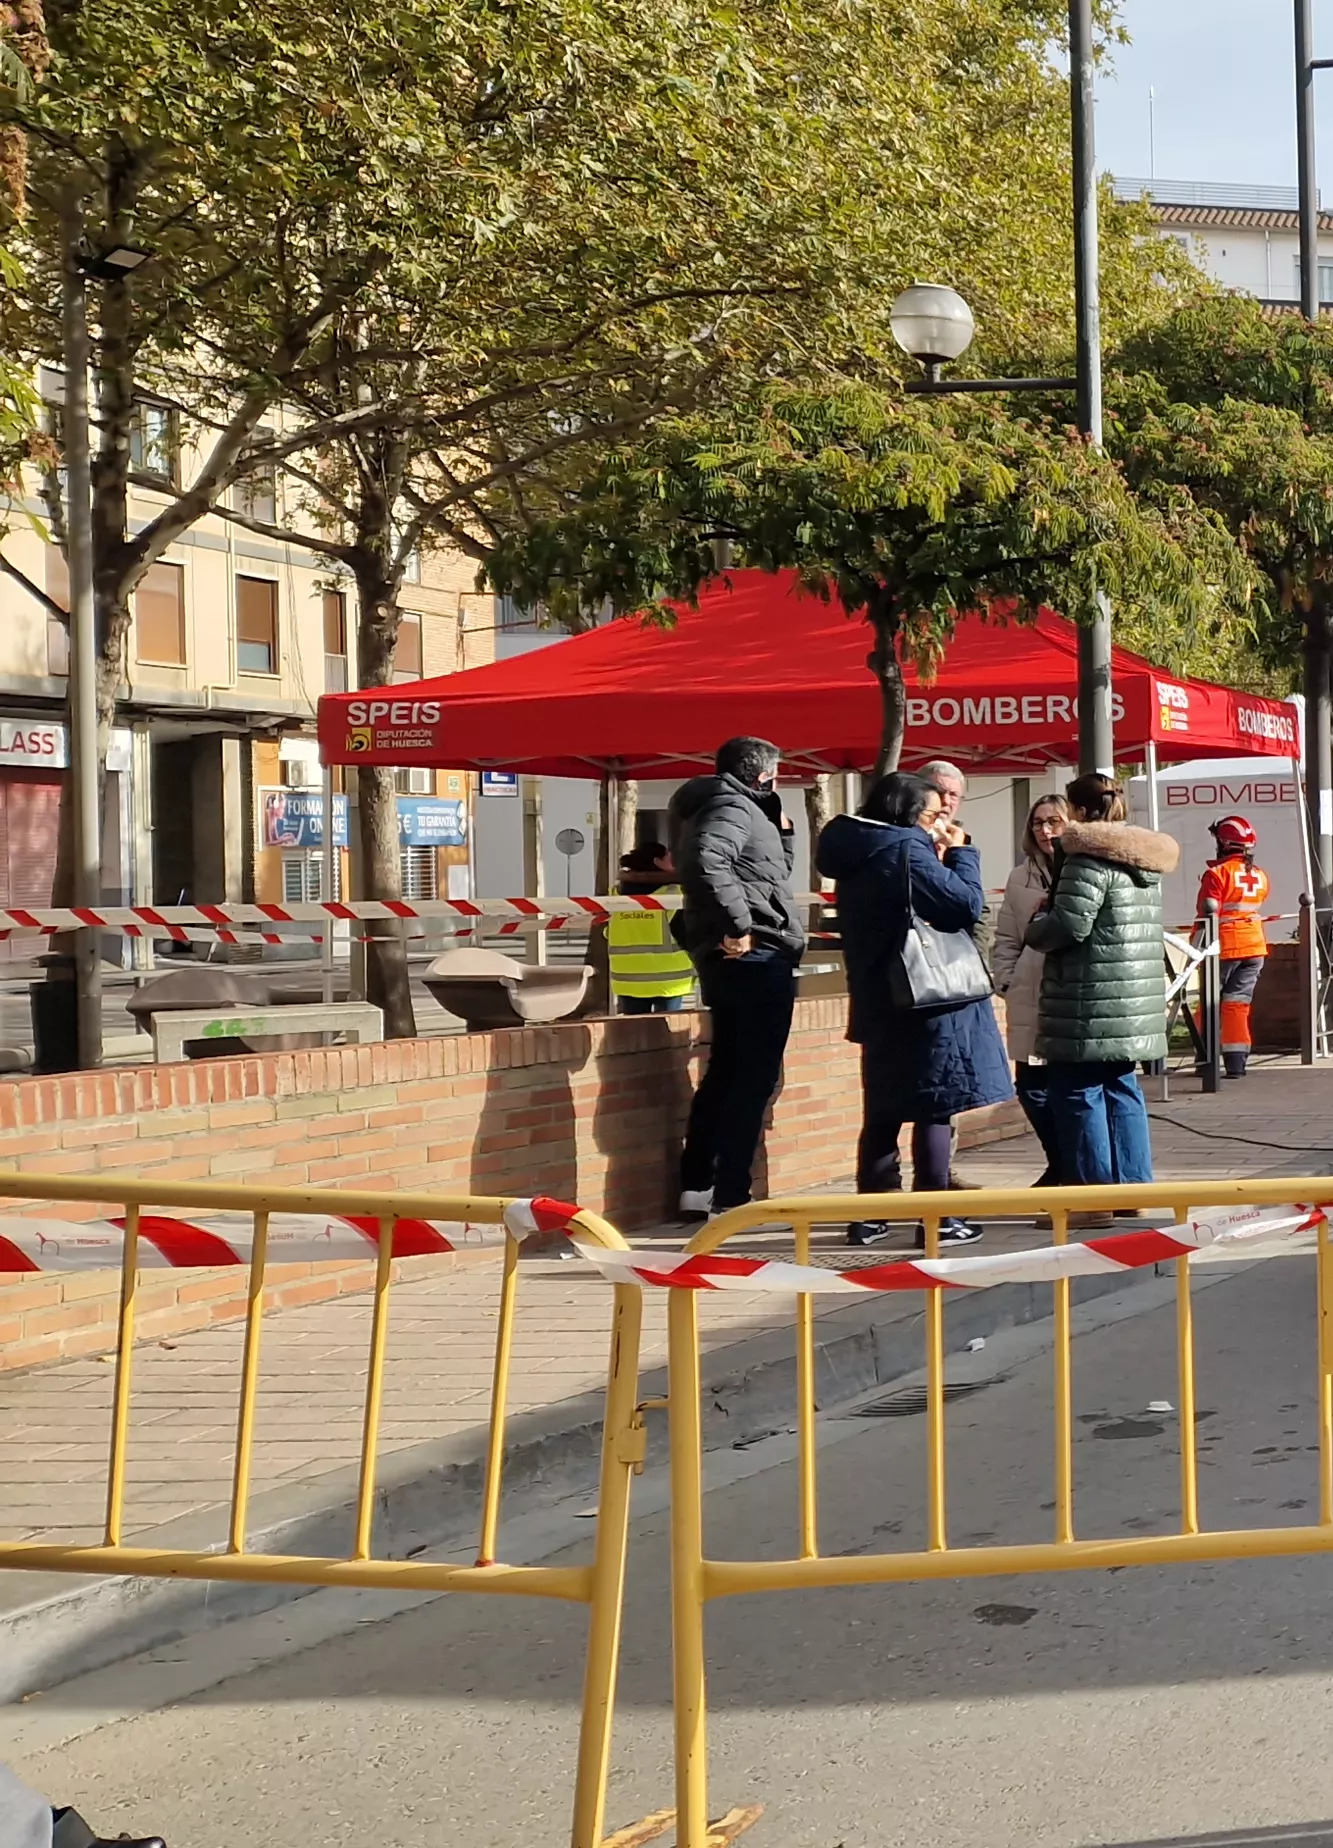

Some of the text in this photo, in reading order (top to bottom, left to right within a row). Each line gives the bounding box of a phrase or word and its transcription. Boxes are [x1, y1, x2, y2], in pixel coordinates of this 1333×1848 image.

[1156, 681, 1188, 709] SPEIS
[347, 701, 441, 725] SPEIS
[906, 693, 1126, 726] BOMBERS
[1238, 707, 1294, 741] BOMBEROS
[376, 729, 432, 738] DIPUTACIÓN
[376, 739, 432, 748] DE HUESCA
[309, 817, 345, 833] ONNE
[620, 912, 654, 920] Sociales
[1228, 1211, 1261, 1223] Huesca
